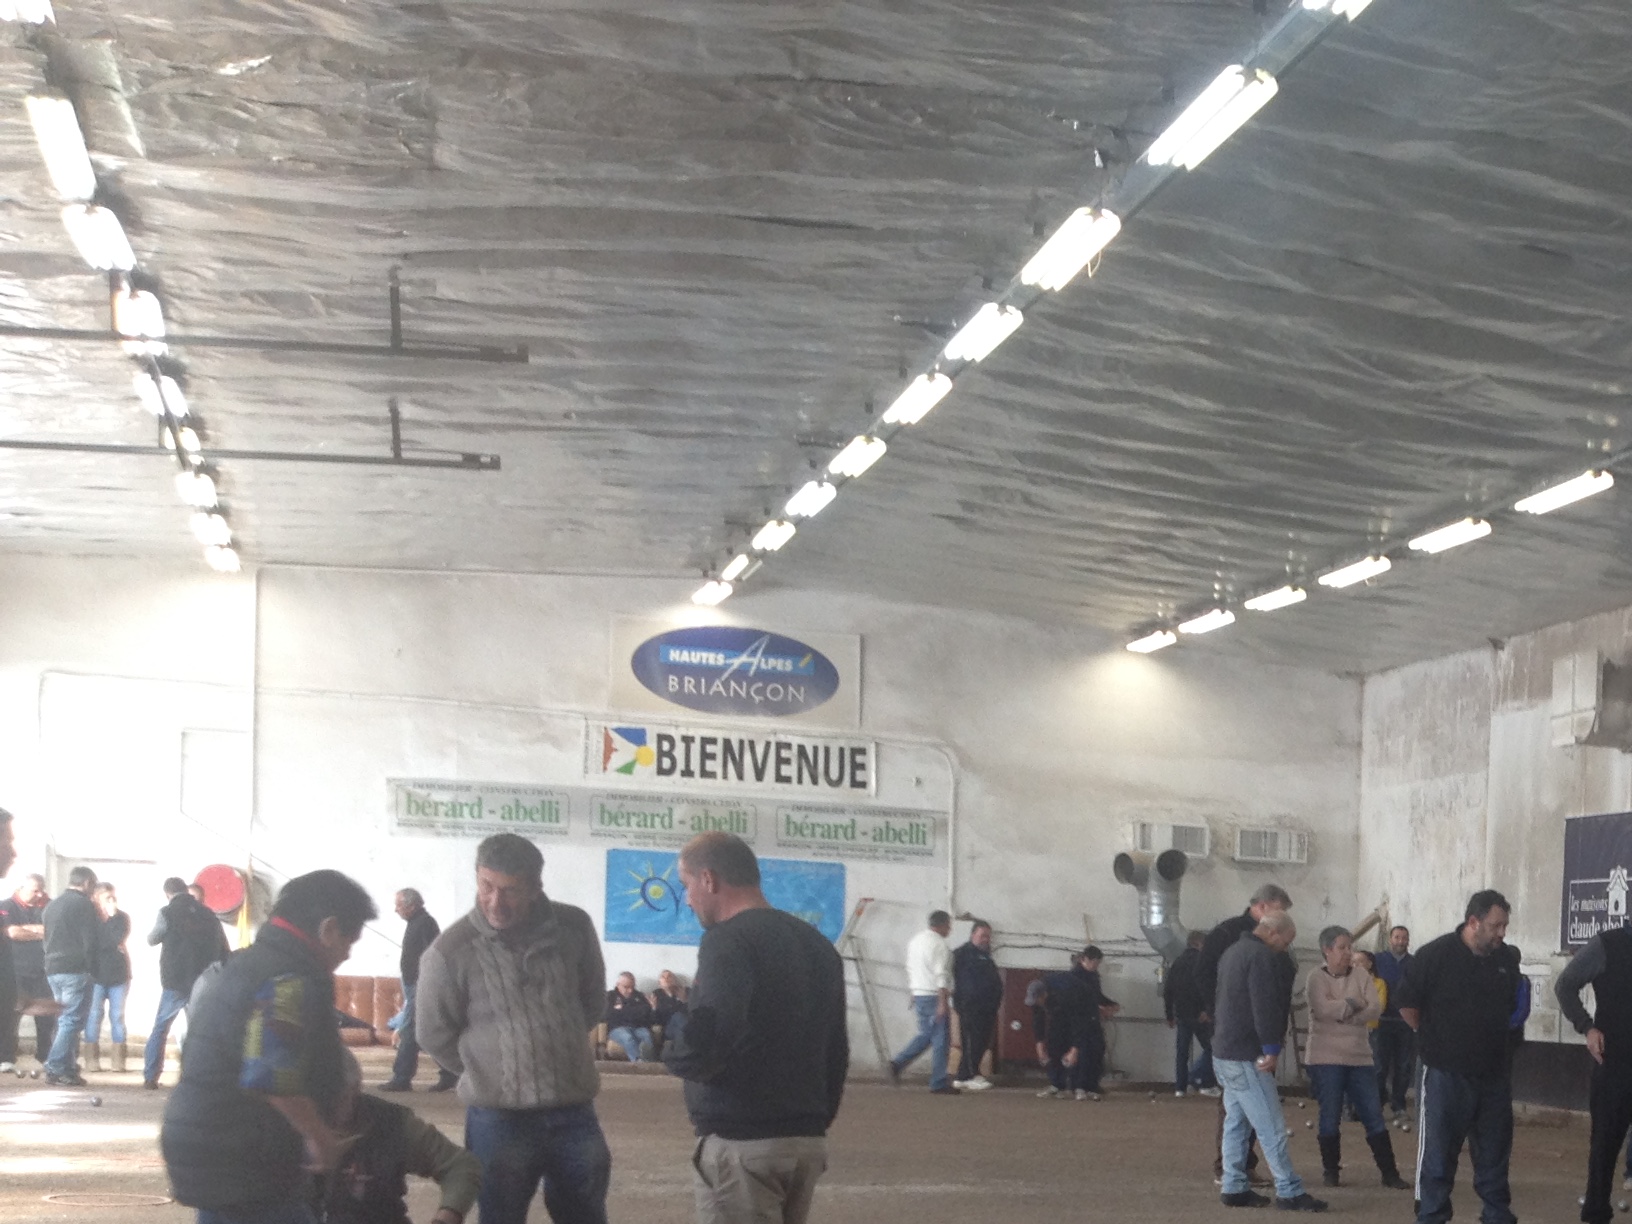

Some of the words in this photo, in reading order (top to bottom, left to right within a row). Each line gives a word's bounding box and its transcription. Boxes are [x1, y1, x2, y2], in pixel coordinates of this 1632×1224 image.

[668, 648, 725, 666] HAUTES
[668, 674, 805, 704] BRIANÇON
[656, 733, 867, 789] BIENVENUE
[405, 790, 483, 819] bérard
[500, 798, 560, 824] abelli
[600, 802, 673, 830] bérard
[690, 809, 747, 834] abelli
[785, 813, 856, 841] bérard
[872, 821, 927, 846] abelli
[1570, 895, 1579, 911] les
[1570, 916, 1600, 939] claude
